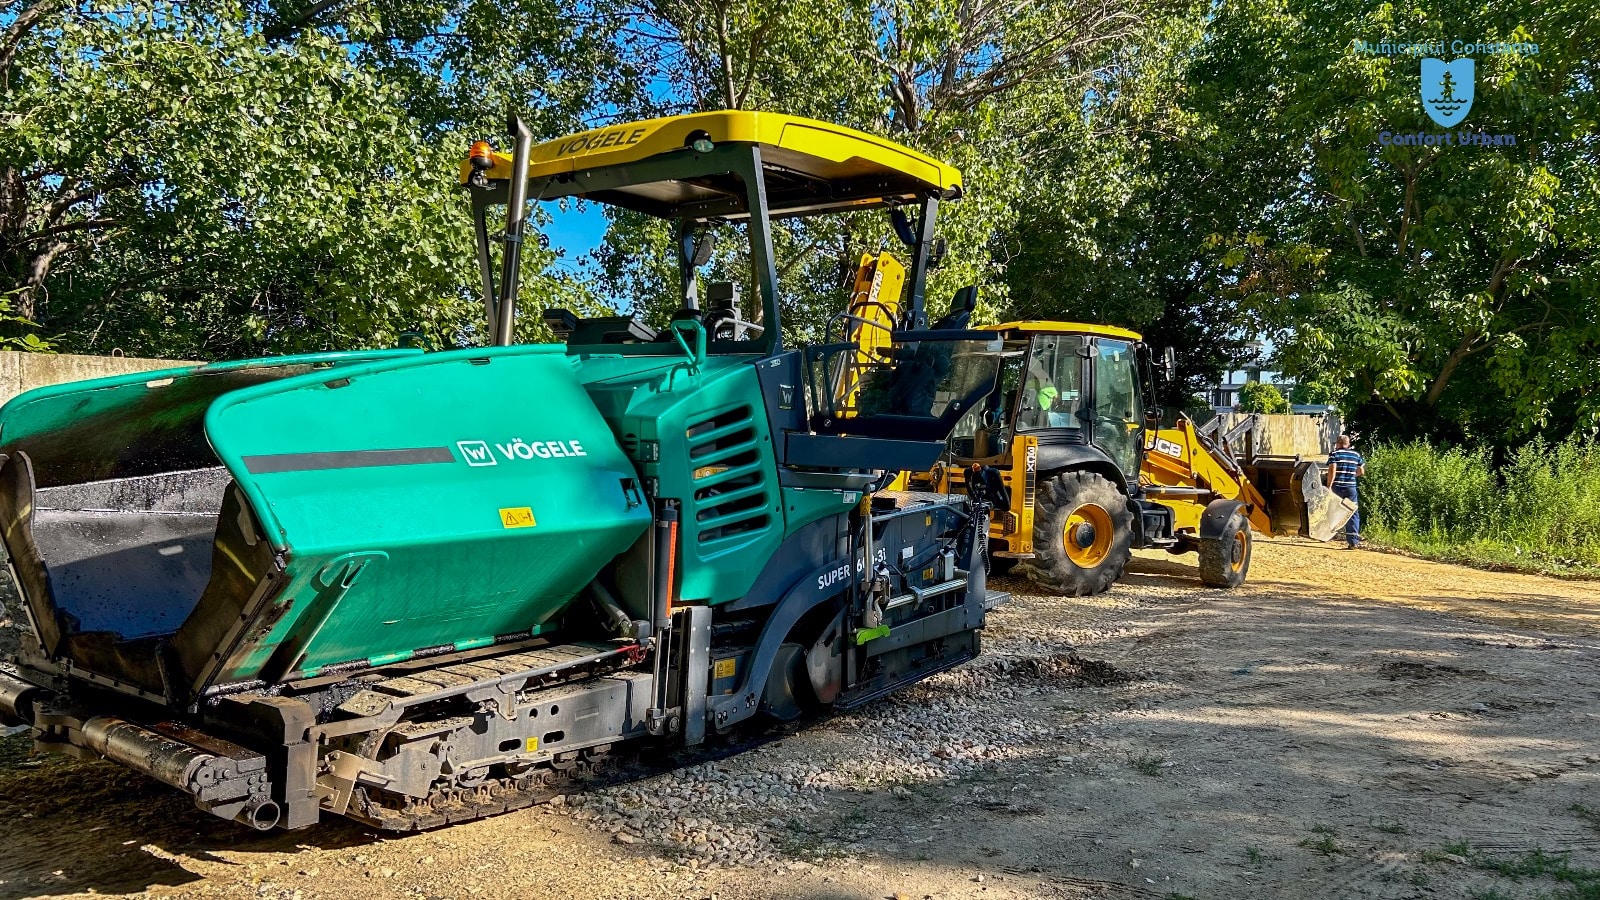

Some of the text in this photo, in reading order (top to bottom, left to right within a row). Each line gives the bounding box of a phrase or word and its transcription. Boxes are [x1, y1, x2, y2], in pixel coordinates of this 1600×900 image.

[557, 128, 646, 156] VÖGELE
[496, 438, 587, 460] VÖGELE
[1026, 446, 1036, 472] 3CX
[818, 564, 851, 590] SUPER
